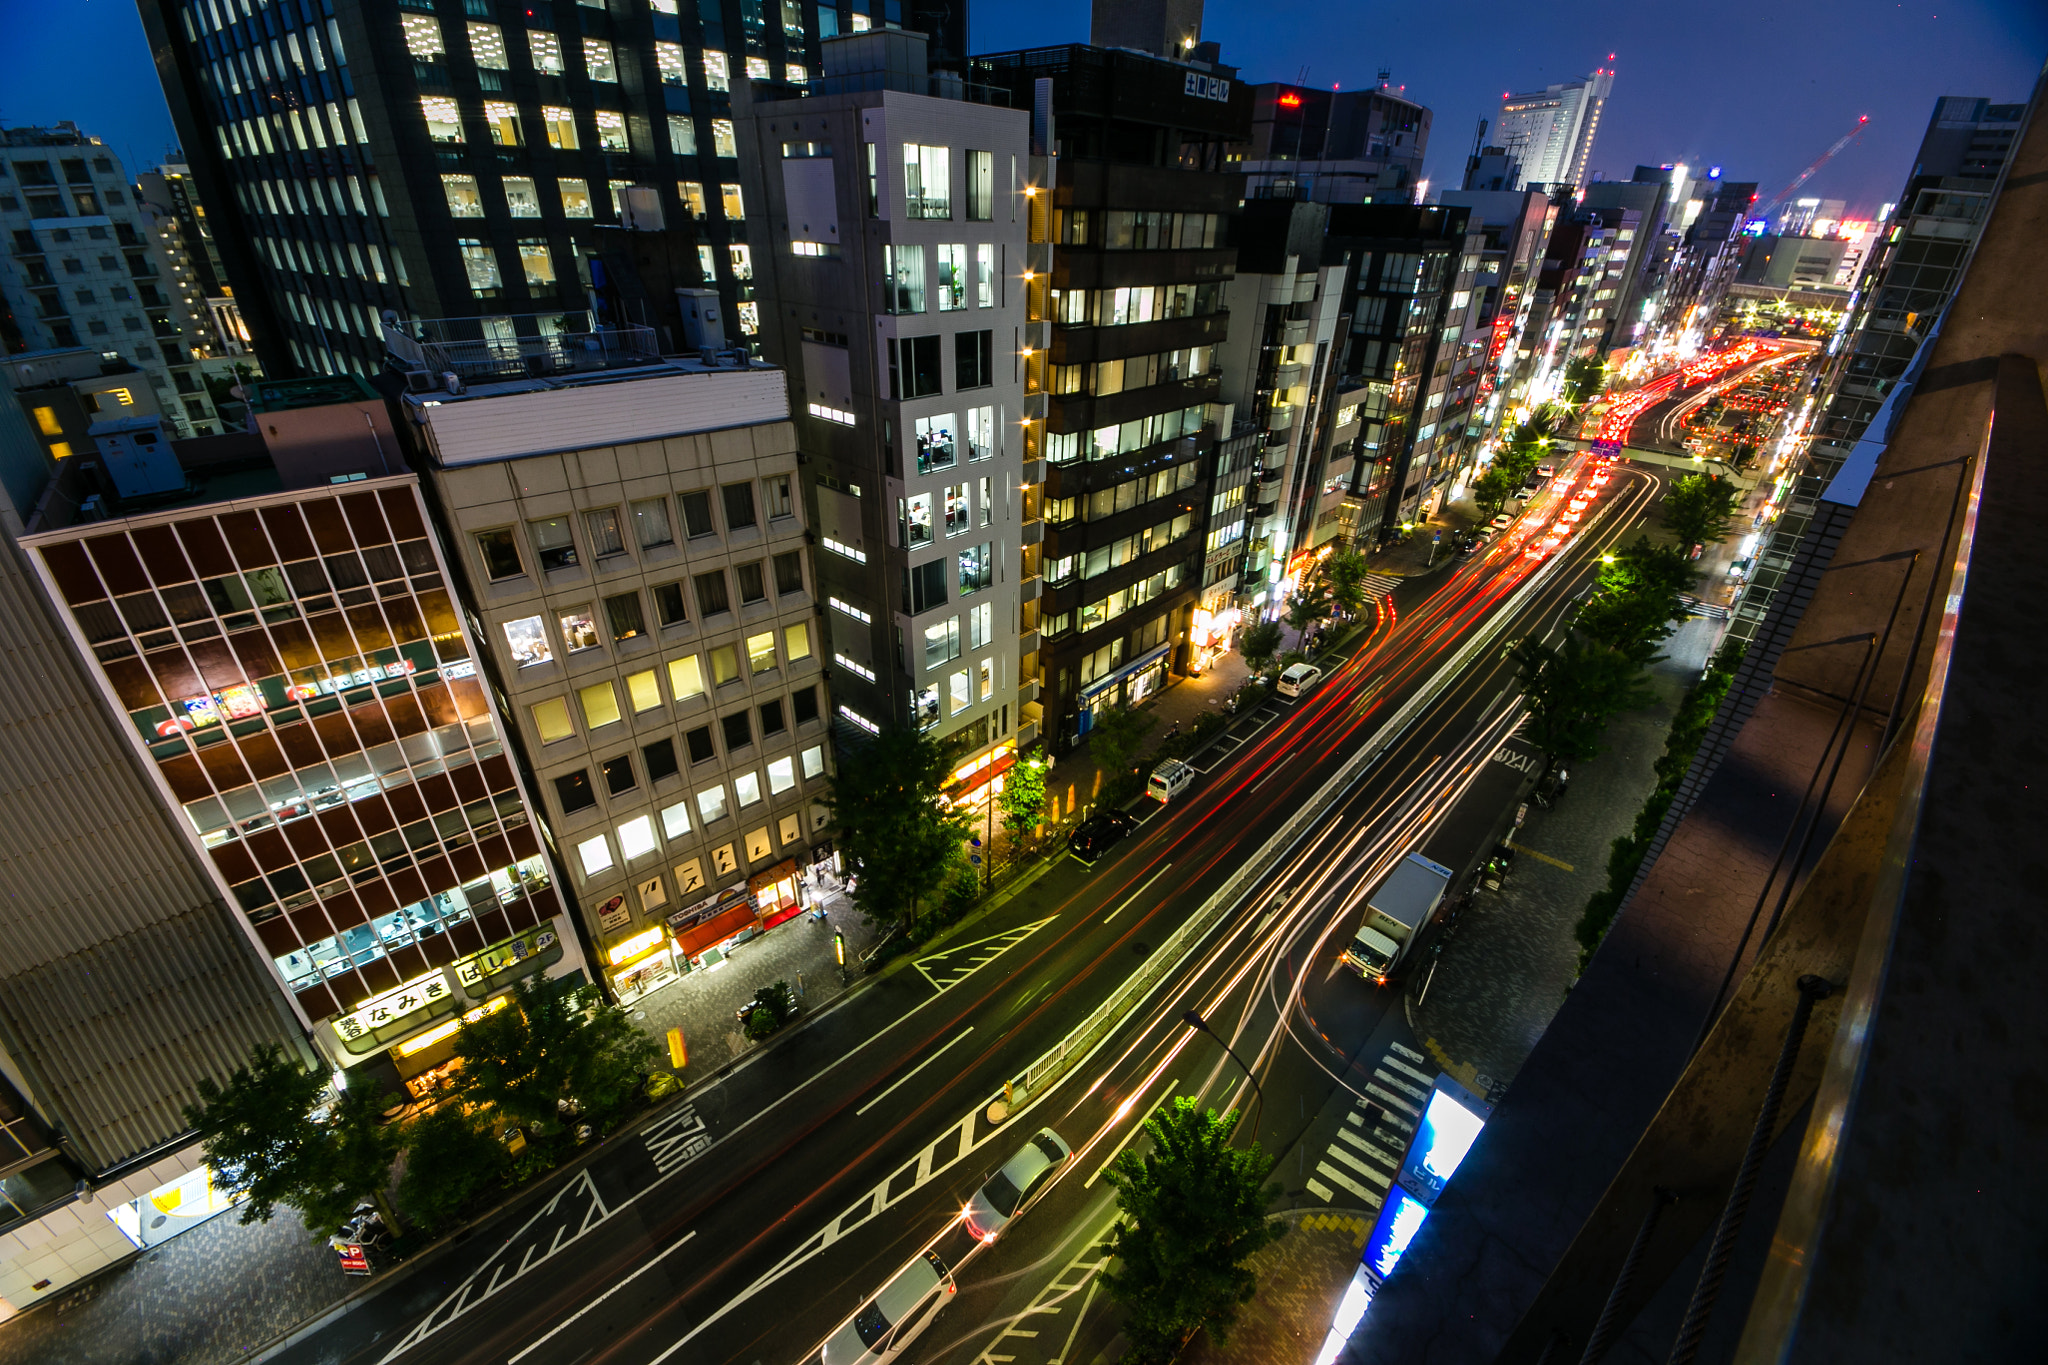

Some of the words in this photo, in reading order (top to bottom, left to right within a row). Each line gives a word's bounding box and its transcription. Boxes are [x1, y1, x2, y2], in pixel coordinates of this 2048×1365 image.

[1185, 73, 1228, 99] 土ビル
[1493, 748, 1536, 773] バス停
[672, 901, 708, 921] TOSHIBA
[538, 934, 552, 945] 2F
[640, 1104, 712, 1173] バス停
[350, 1247, 360, 1257] P
